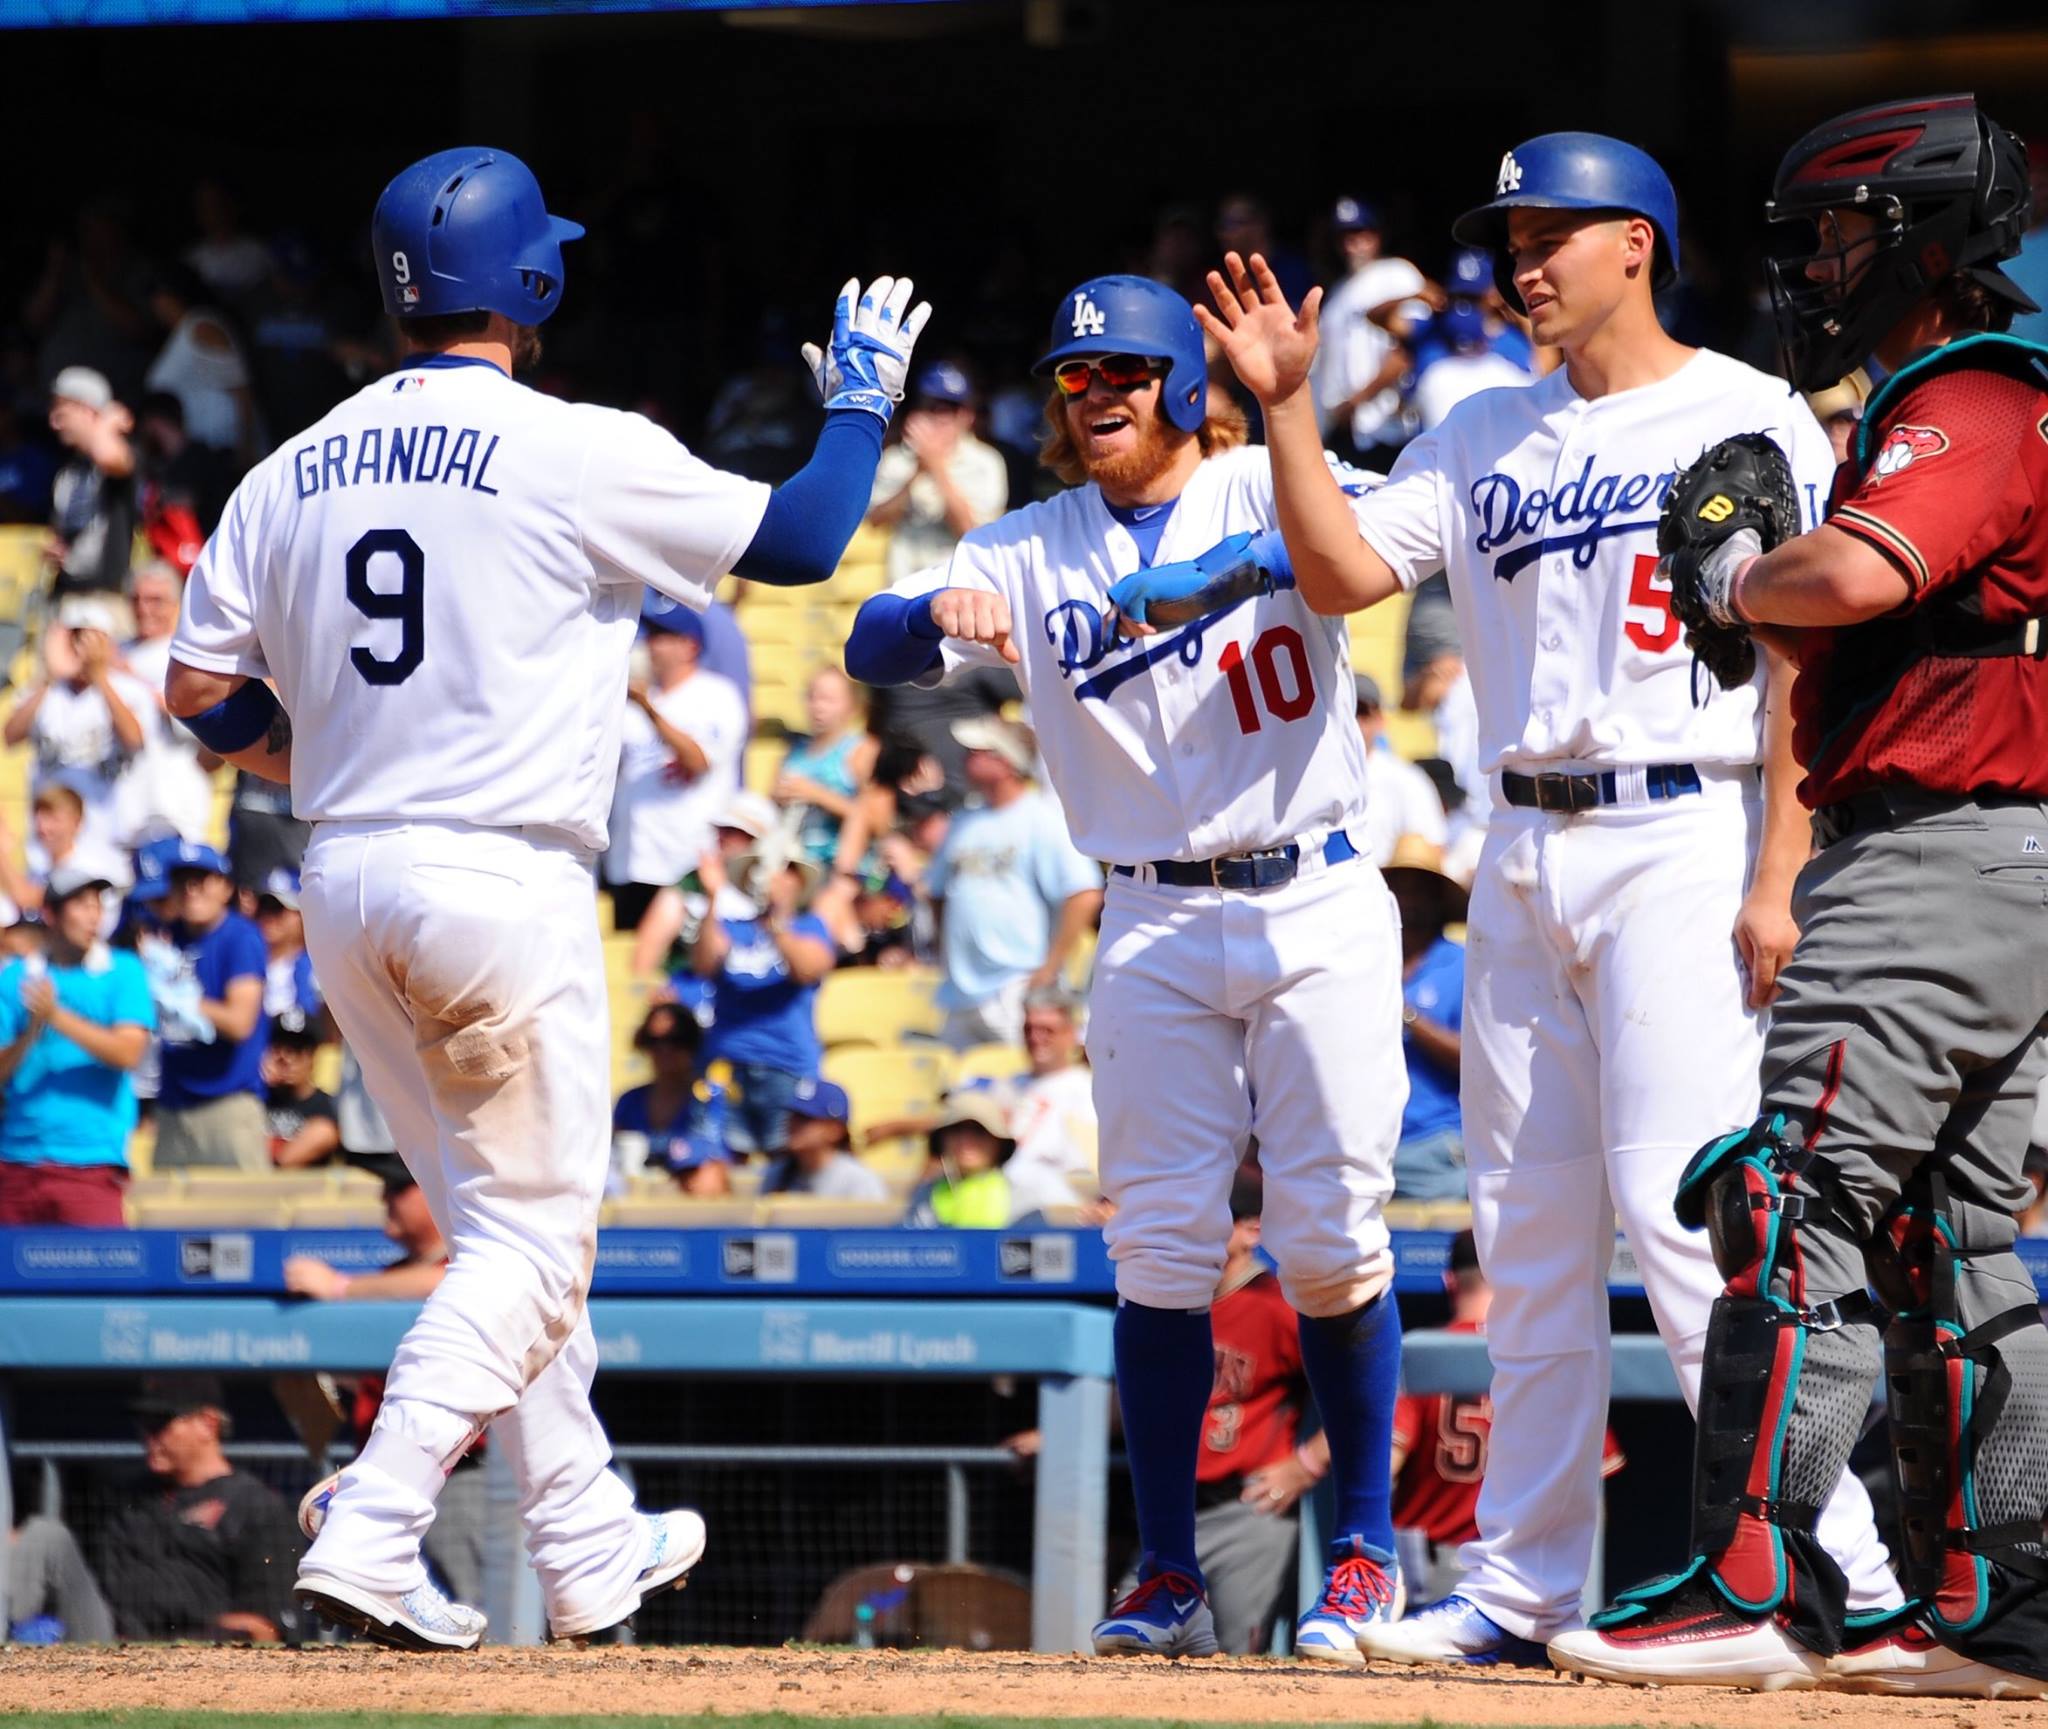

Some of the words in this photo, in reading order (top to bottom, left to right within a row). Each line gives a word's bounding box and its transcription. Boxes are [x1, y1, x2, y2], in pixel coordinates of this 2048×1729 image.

[392, 251, 410, 284] 9
[1072, 292, 1105, 337] LA
[294, 425, 501, 500] GRANDAL
[1471, 454, 1677, 570] Dodger
[345, 528, 425, 686] 9
[1624, 553, 1682, 655] 5
[1217, 624, 1317, 736] 10
